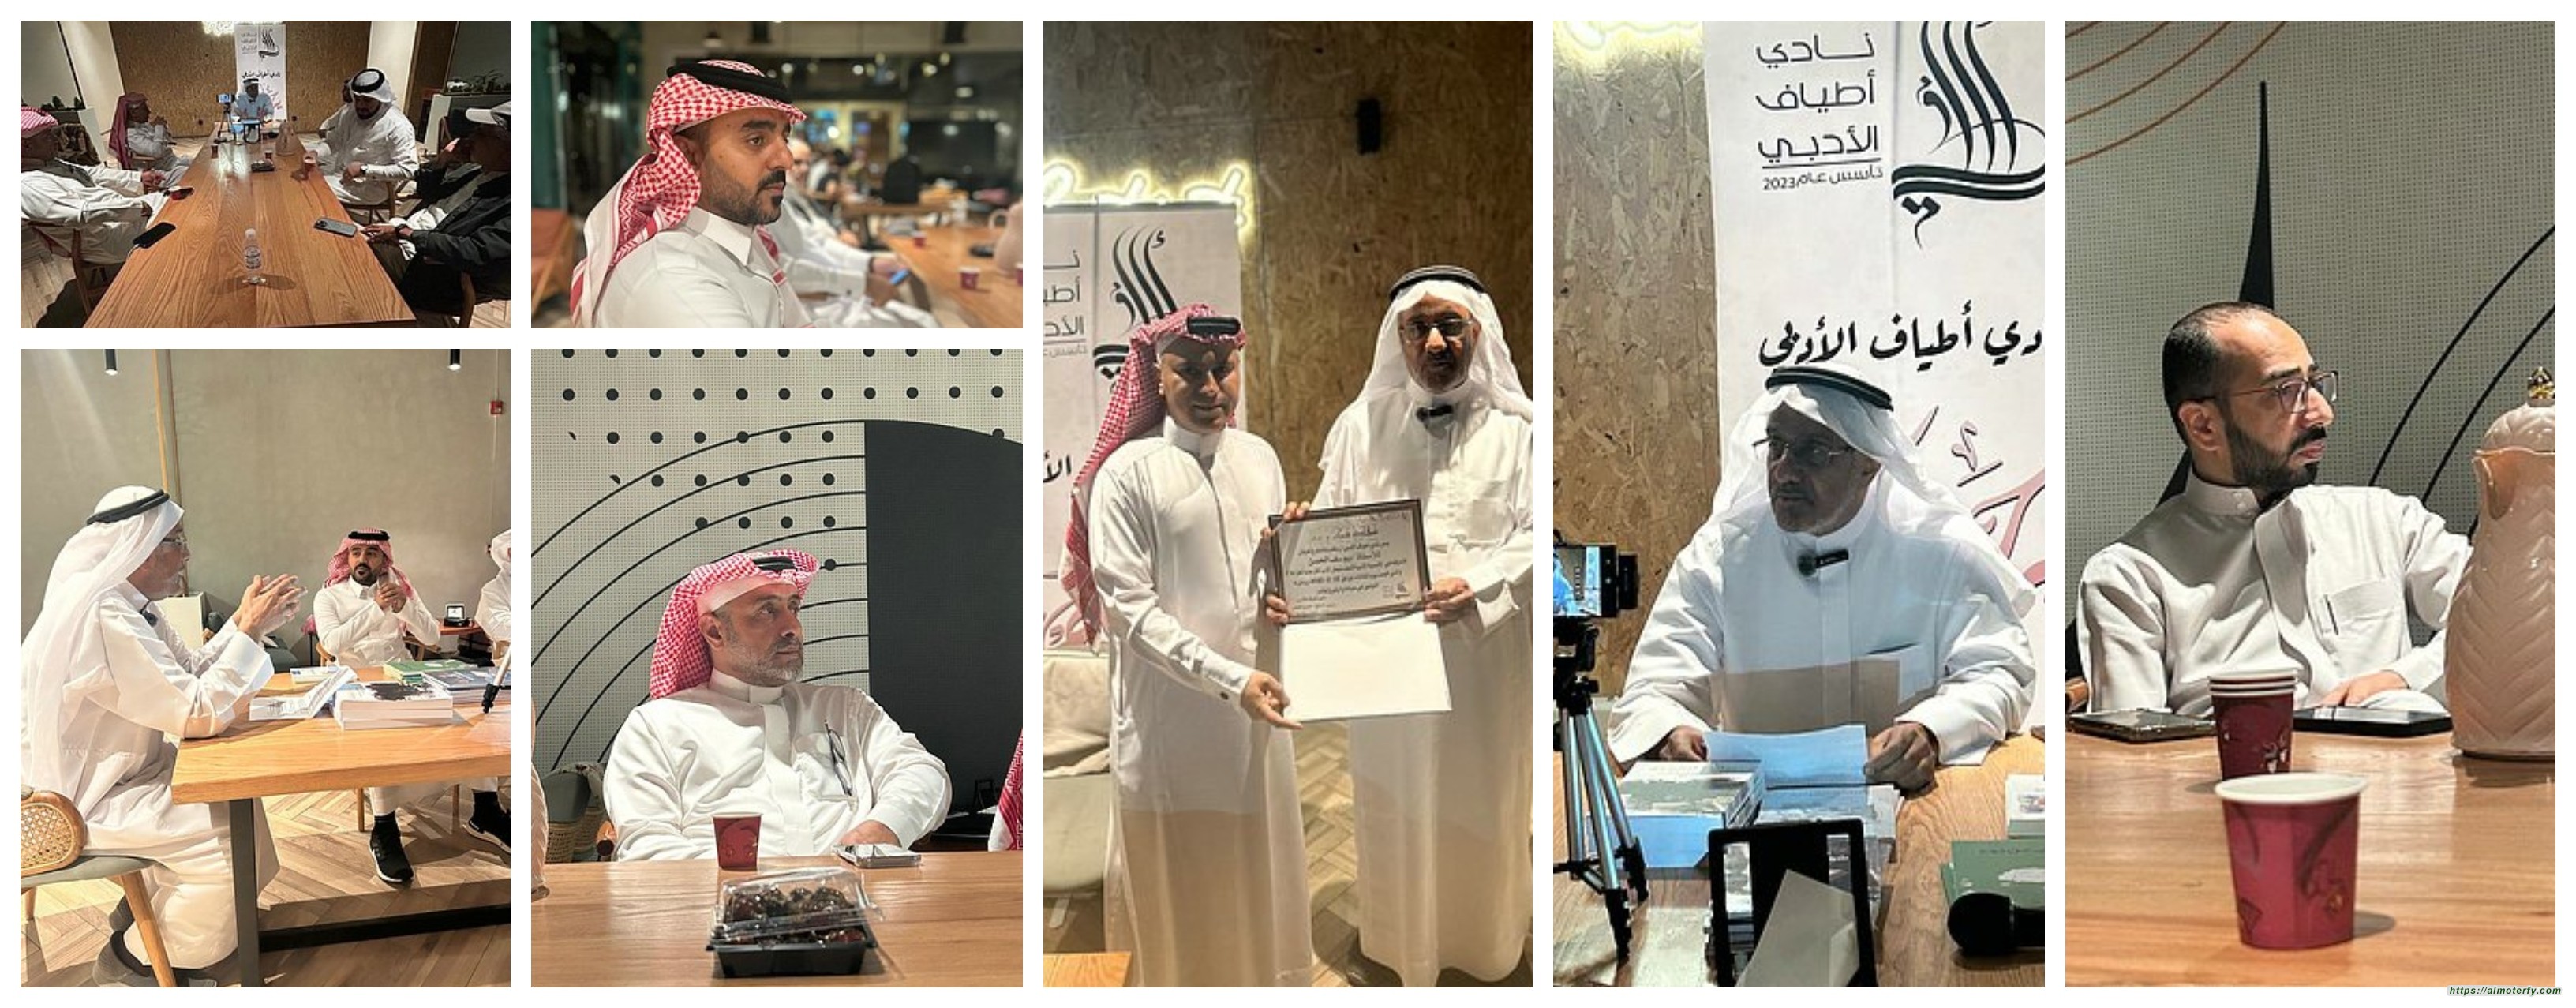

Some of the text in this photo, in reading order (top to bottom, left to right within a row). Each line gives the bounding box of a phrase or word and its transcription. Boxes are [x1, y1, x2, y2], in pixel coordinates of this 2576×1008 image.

[1756, 32, 1874, 69] نادي
[1755, 69, 1875, 113] أطياف
[1758, 126, 1878, 163] الأدبي
[1762, 177, 1796, 191] 2023
[1870, 300, 1972, 372] أطياف
